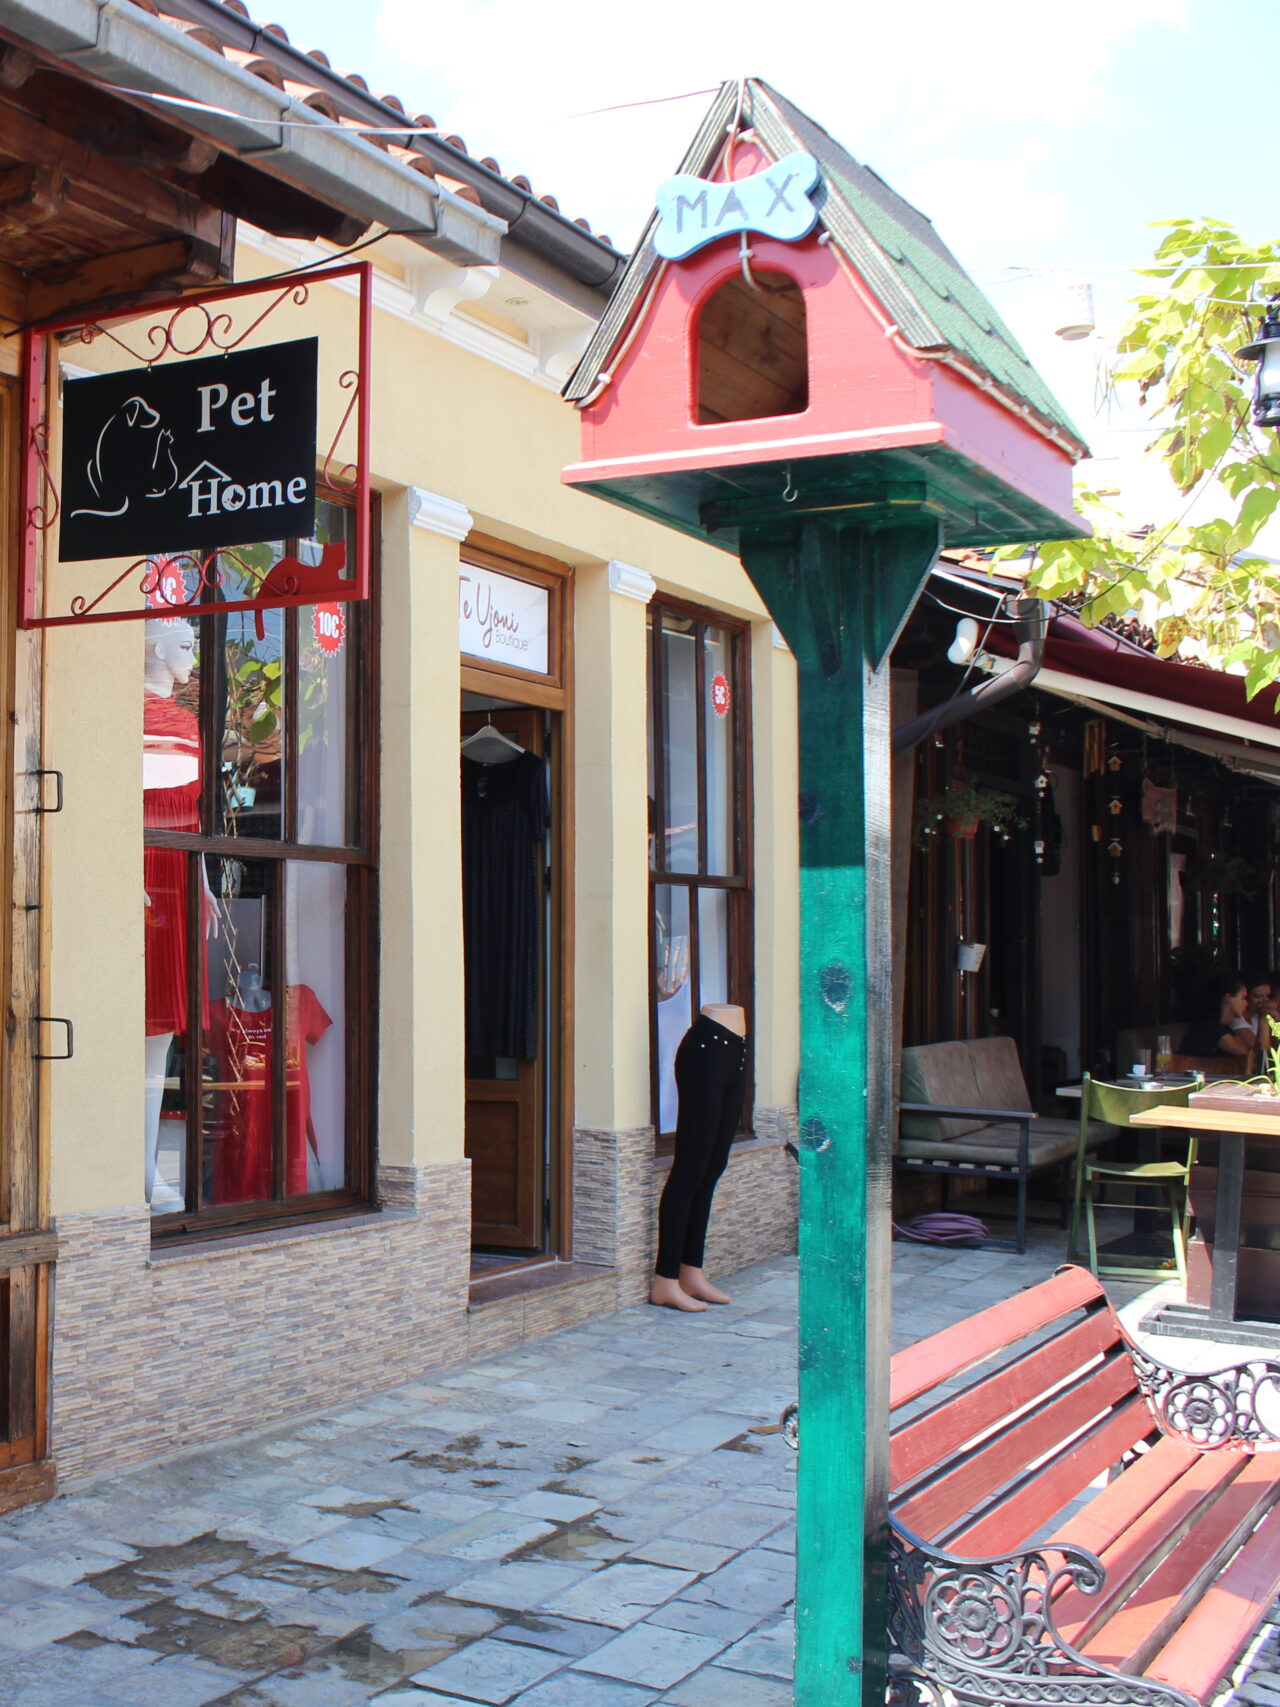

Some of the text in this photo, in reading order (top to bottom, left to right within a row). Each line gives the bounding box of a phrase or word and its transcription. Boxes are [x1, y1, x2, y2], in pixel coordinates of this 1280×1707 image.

[676, 172, 797, 234] MAX
[196, 377, 277, 434] Pet
[187, 475, 308, 518] Home
[317, 611, 340, 639] 10€
[495, 629, 529, 652] Boutique
